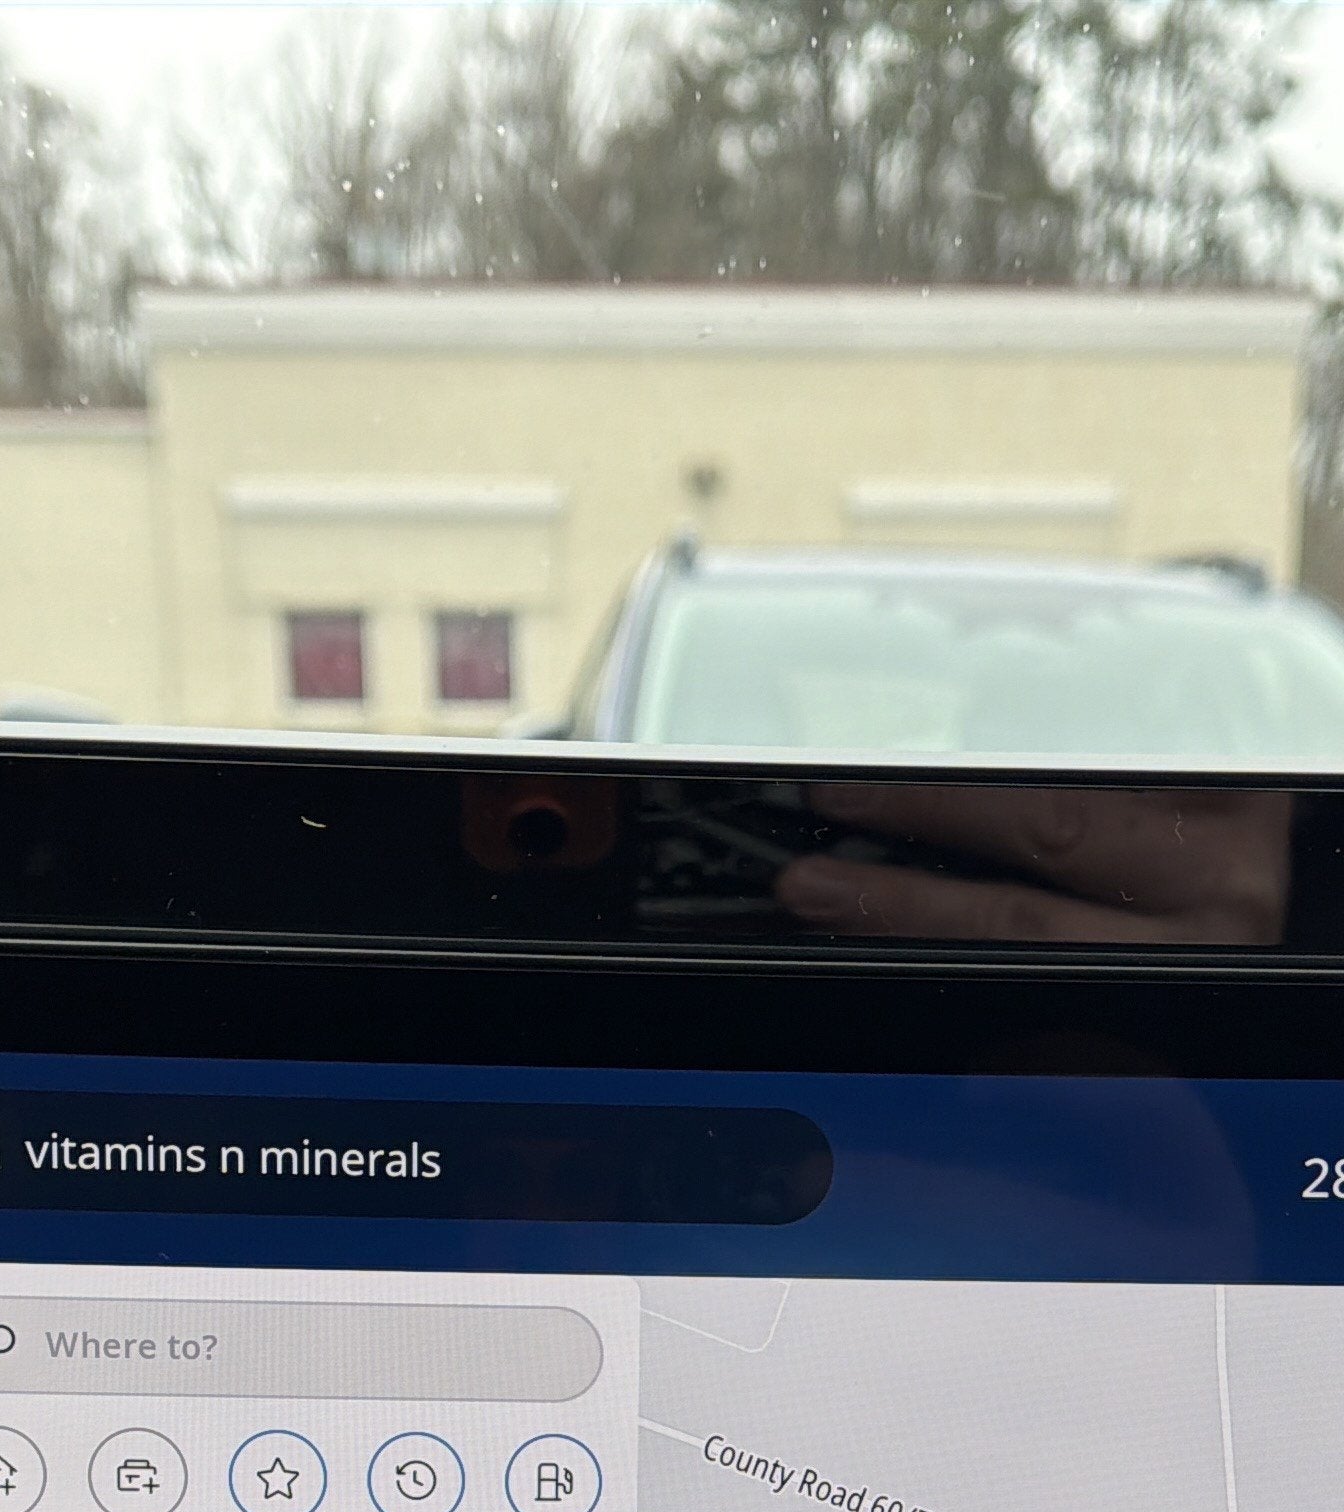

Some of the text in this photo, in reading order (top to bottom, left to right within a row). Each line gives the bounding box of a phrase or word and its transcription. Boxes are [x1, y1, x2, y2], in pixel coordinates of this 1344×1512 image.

[24, 1132, 206, 1173] vitamins
[220, 1146, 244, 1174] n
[261, 1138, 441, 1178] minerals
[44, 1331, 219, 1361] Where to?
[703, 1435, 796, 1494] County
[797, 1468, 868, 1512] Road
